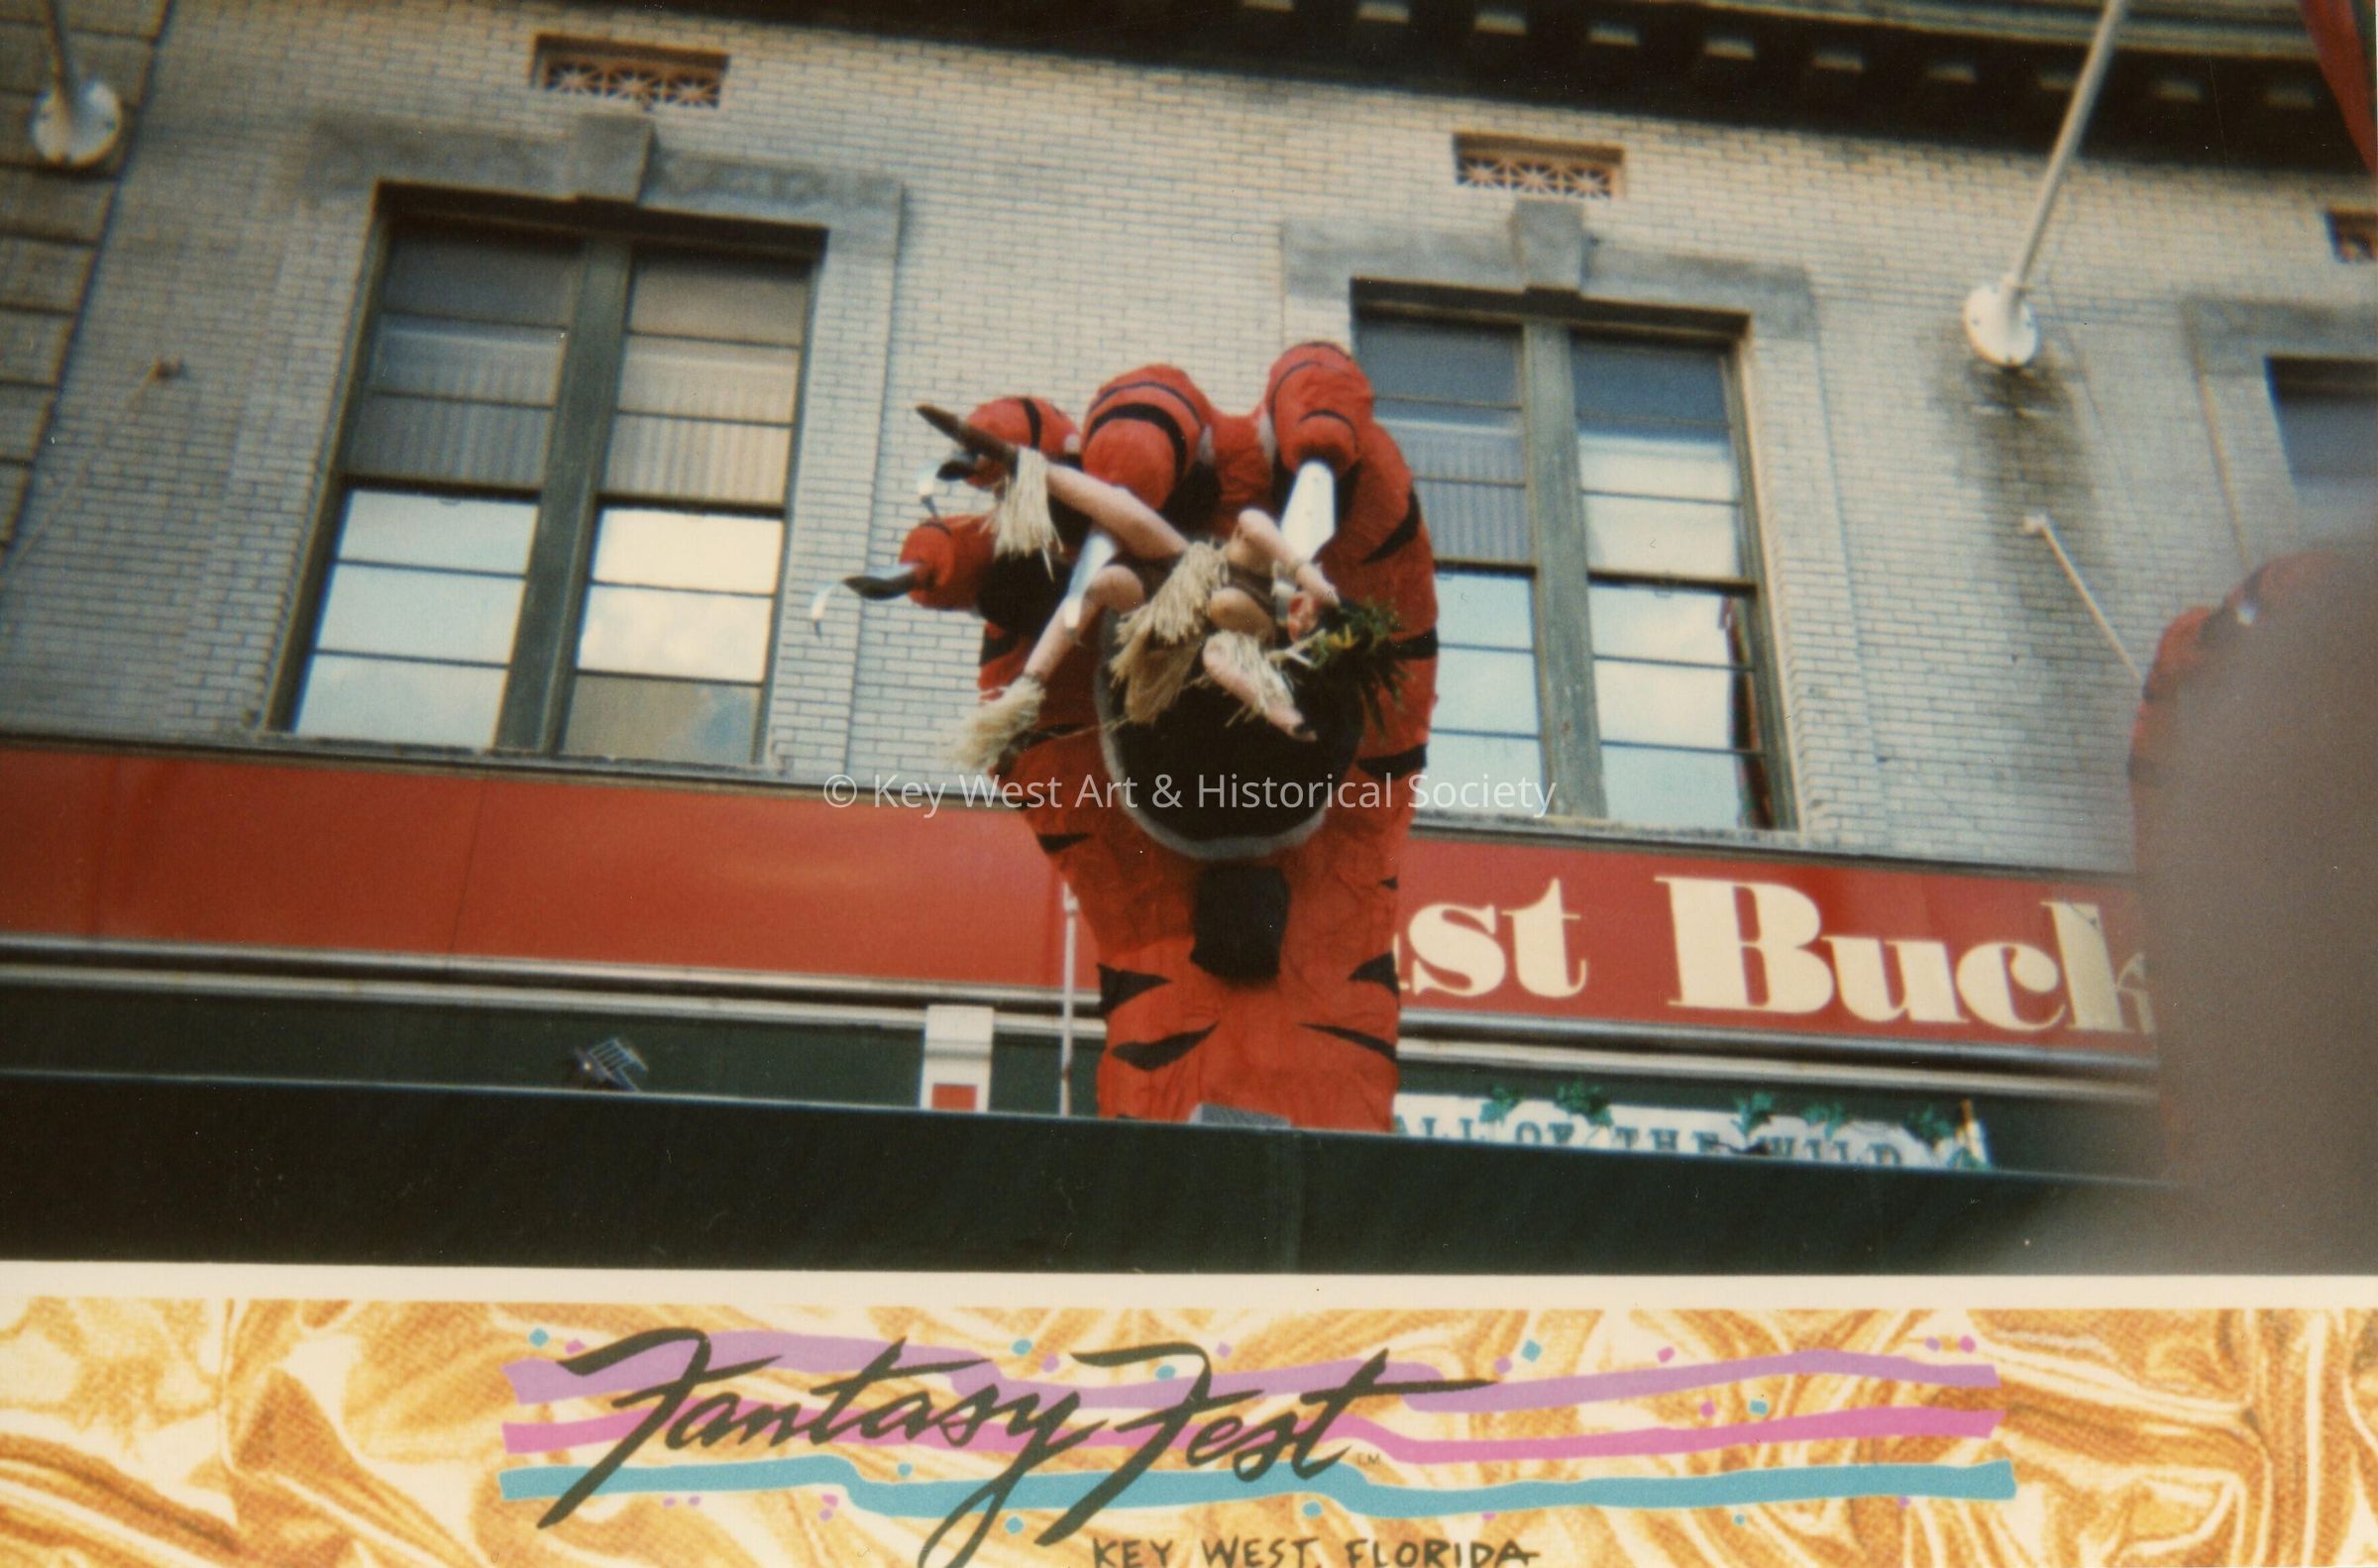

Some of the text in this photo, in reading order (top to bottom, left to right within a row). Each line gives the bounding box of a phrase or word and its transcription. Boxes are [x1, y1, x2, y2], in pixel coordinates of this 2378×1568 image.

[1393, 878, 1587, 998] st
[1614, 1126, 1719, 1154] THE
[537, 1327, 1108, 1568] Fantasy
[1034, 1341, 1498, 1546] Fest
[1093, 1537, 1173, 1568] KEY
[1345, 1538, 1540, 1568] FLORIDA
